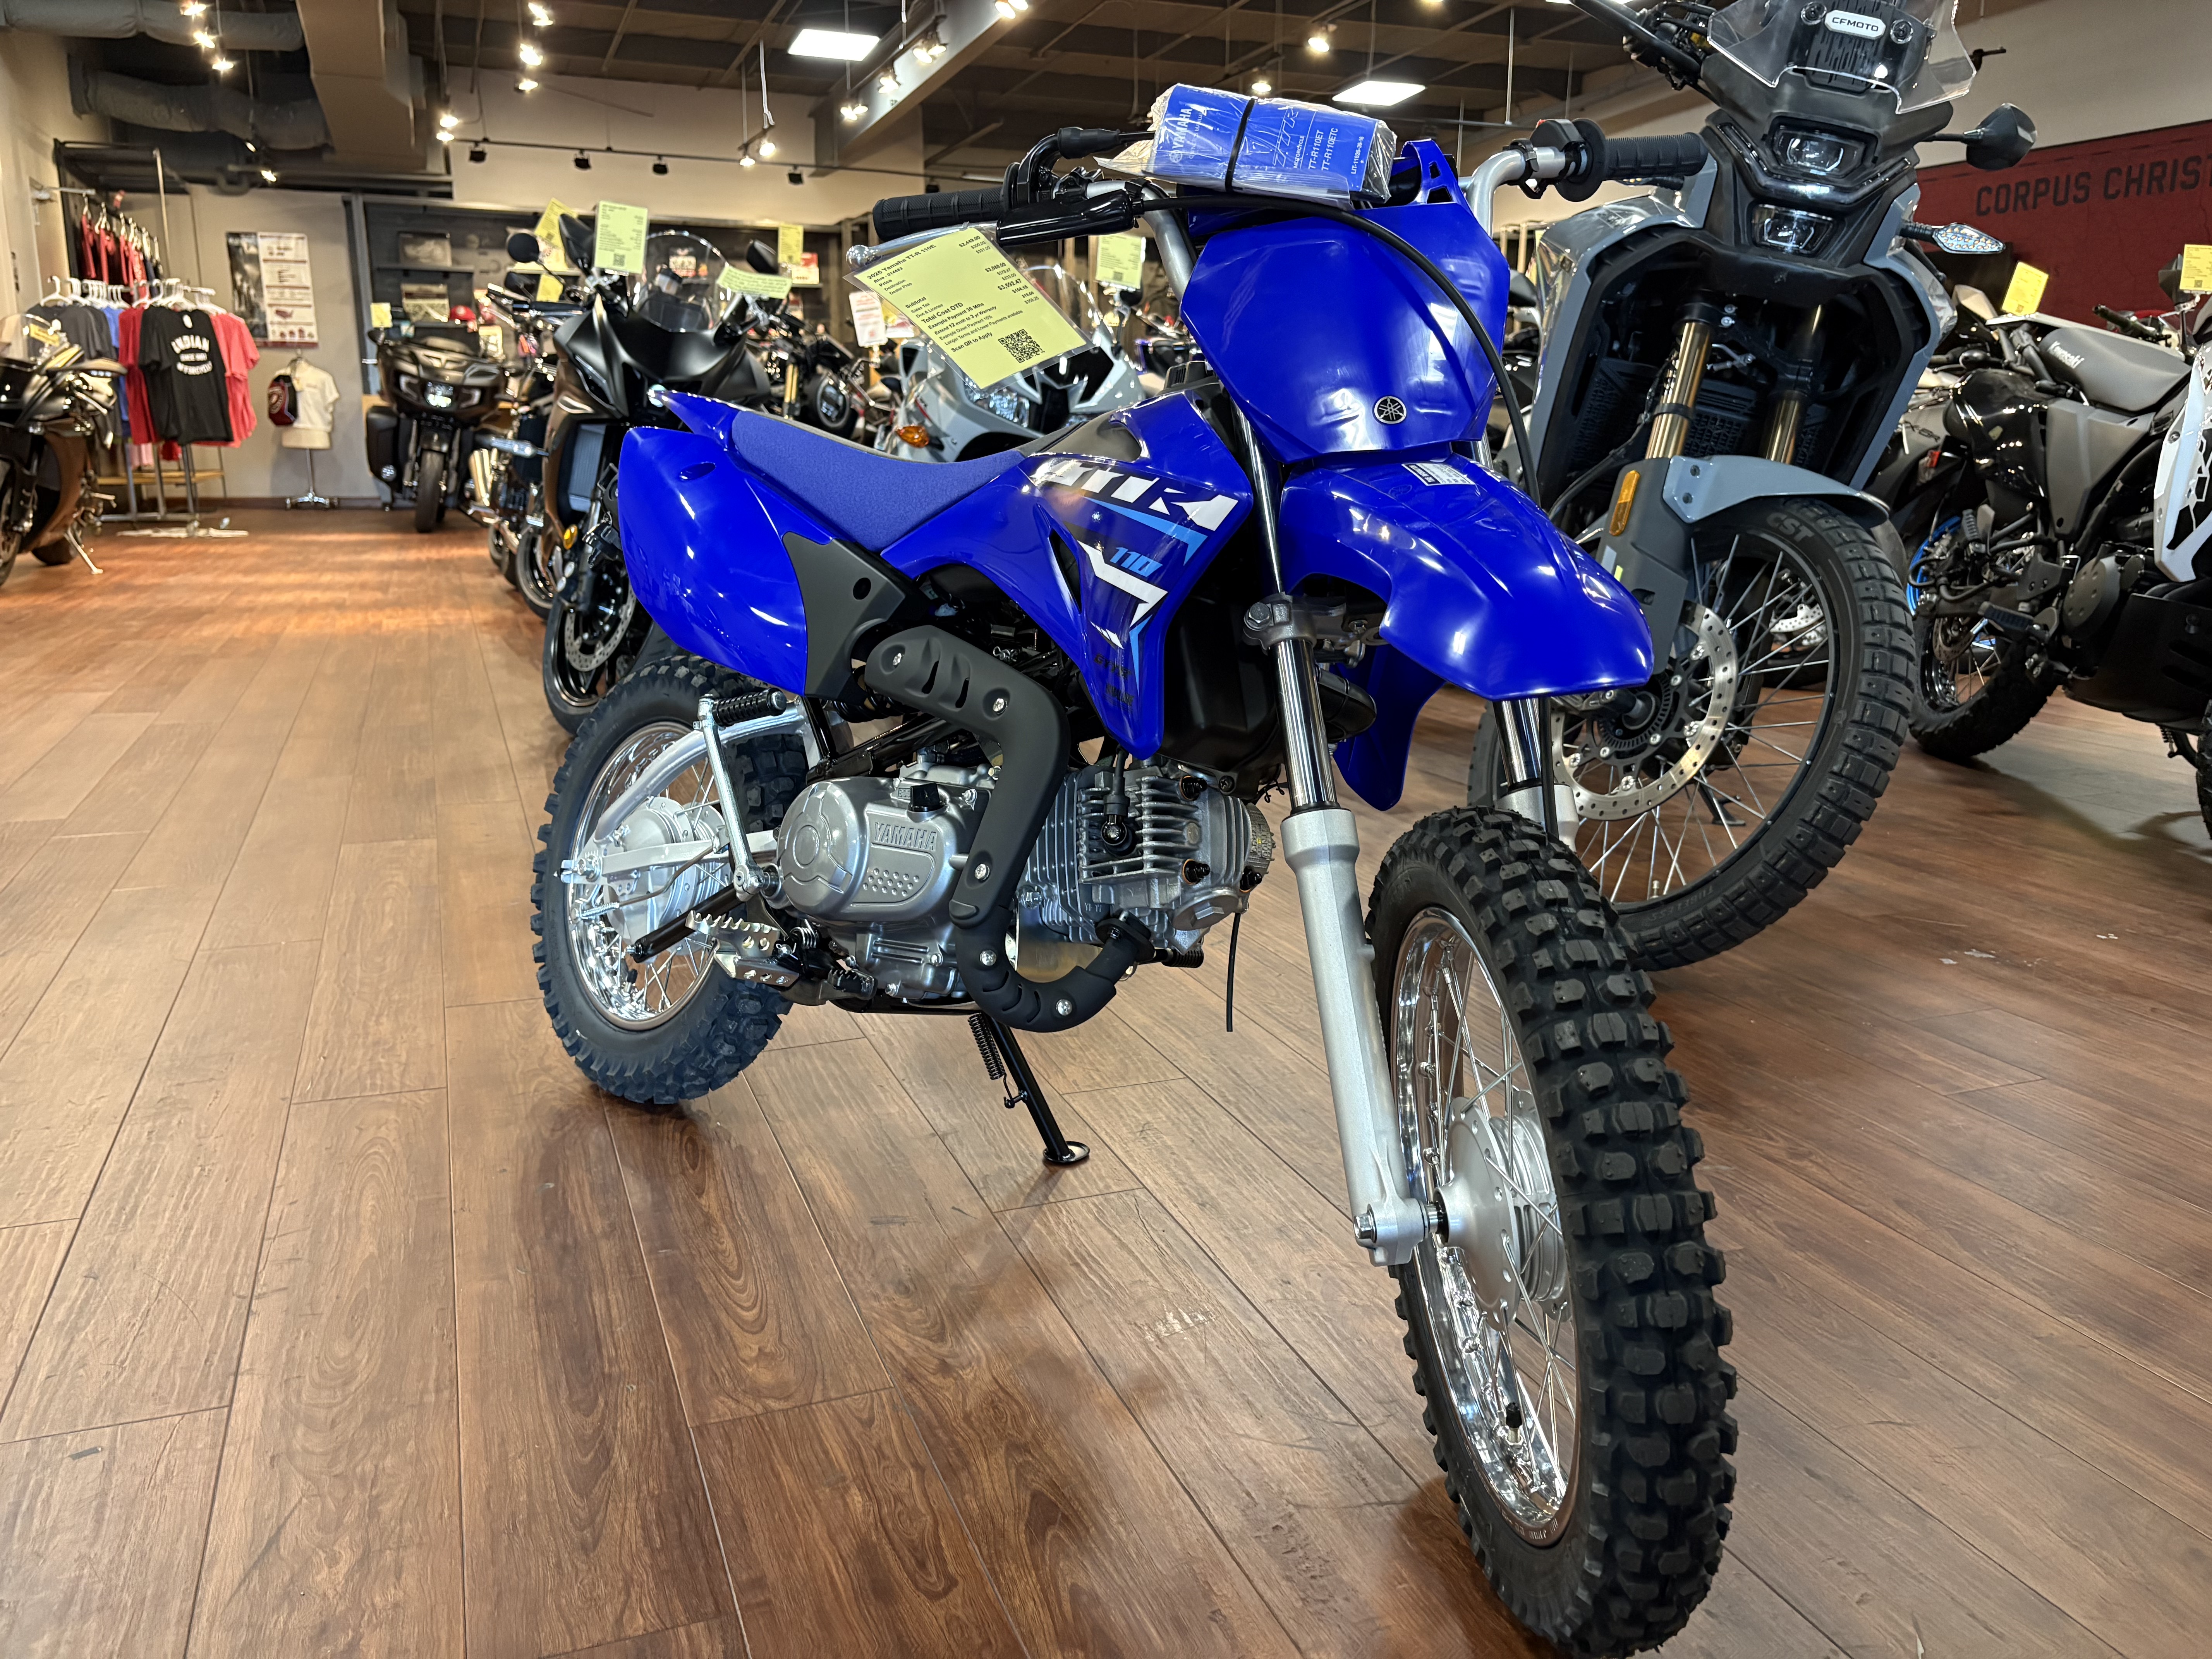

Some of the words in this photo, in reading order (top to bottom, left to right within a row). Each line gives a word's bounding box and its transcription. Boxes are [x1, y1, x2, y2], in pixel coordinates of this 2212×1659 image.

[1832, 17, 1879, 31] CFMOTO
[1172, 109, 1192, 149] YAMAHA
[1293, 136, 1305, 168] MOTORCYCLE
[1308, 130, 1324, 169] TT-R110ET
[1321, 128, 1338, 170] TT-R110ETC
[1977, 172, 2091, 216] CORPUS
[867, 271, 882, 279] 2026
[882, 259, 906, 271] Yamaha
[905, 251, 921, 259] TT-R
[921, 244, 936, 252] 110E
[905, 297, 926, 308] Subtotal
[921, 314, 937, 323] Total
[936, 308, 951, 316] Cost
[928, 319, 948, 329] Example
[947, 310, 967, 321] Payment
[934, 327, 949, 335] Extend
[979, 306, 996, 315] Warranty
[939, 331, 957, 340] Example
[967, 319, 984, 328] Payment
[171, 335, 209, 354] INDIAN
[978, 332, 993, 340] Apply
[1766, 512, 1815, 542] CST
[1110, 547, 1163, 577] 110
[875, 822, 937, 851] YAMAHA
